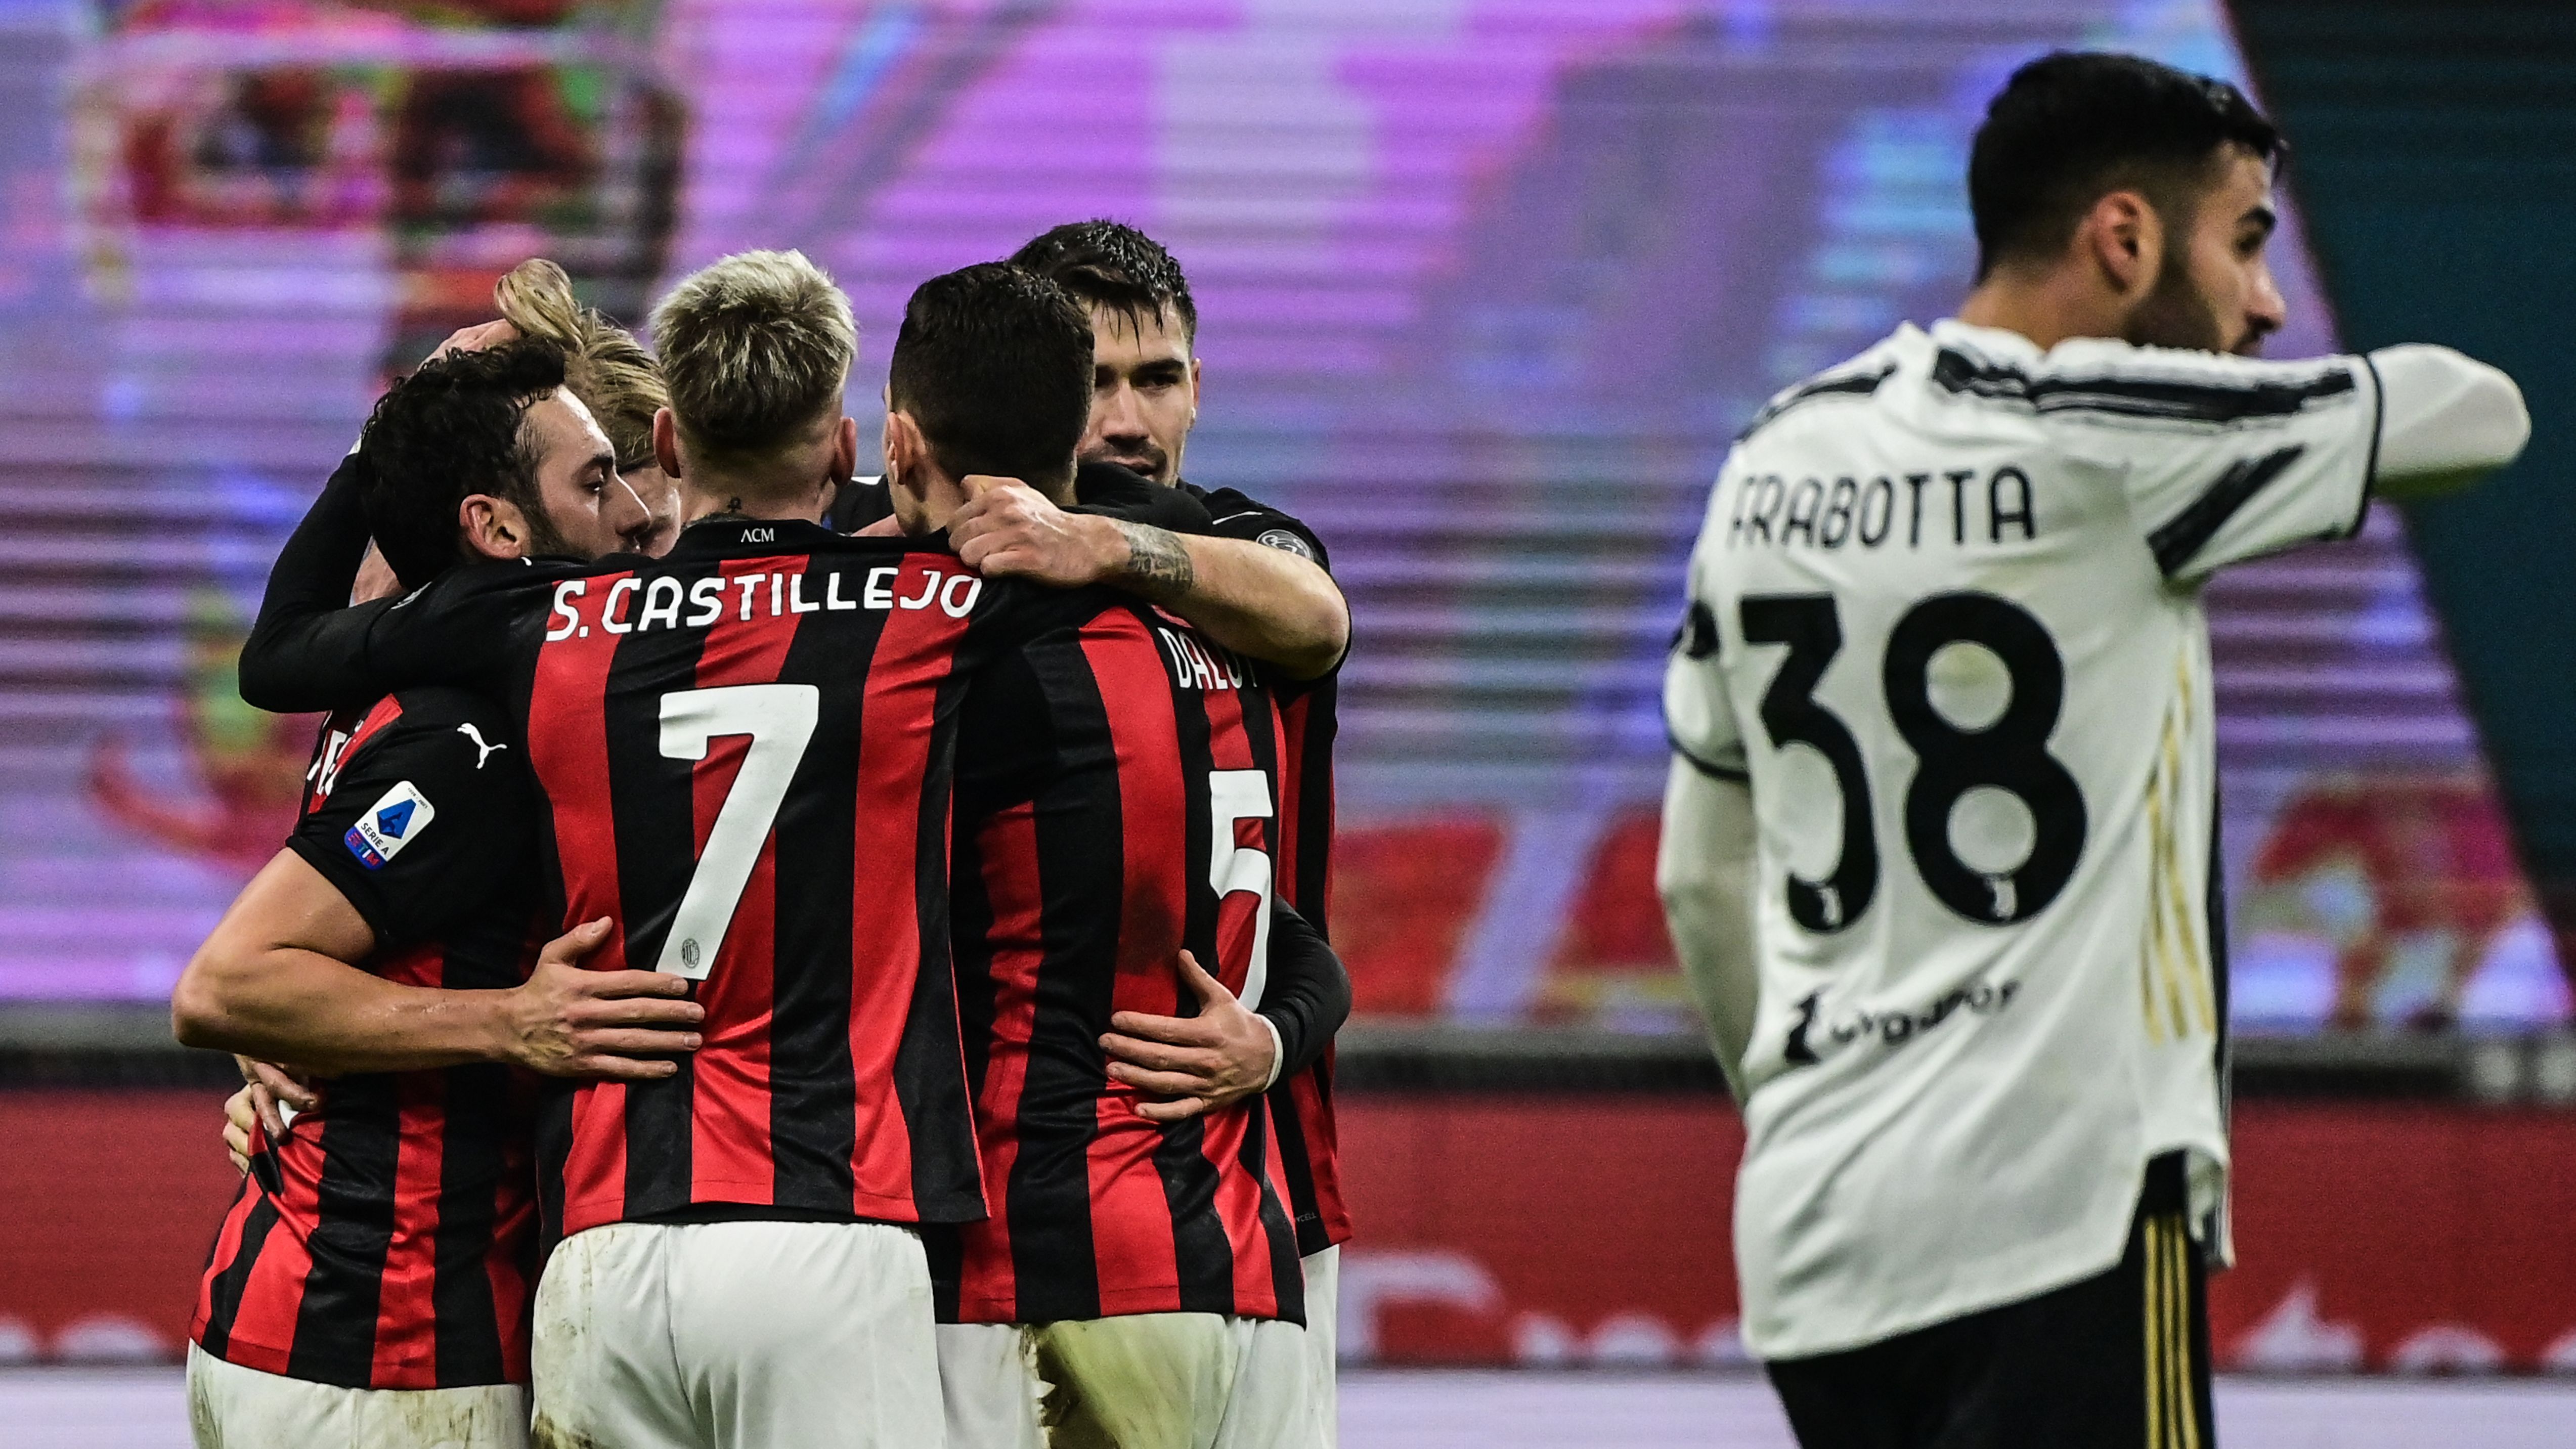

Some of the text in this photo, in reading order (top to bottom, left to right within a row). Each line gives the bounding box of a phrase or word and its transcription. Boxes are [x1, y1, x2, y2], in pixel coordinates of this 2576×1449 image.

[740, 528, 774, 543] ACM
[1726, 465, 2036, 549] FRABOTTA
[361, 822, 389, 855] SERIE A
[656, 683, 820, 980] 7
[1738, 590, 2088, 934] 38
[1209, 770, 1274, 1012] 5
